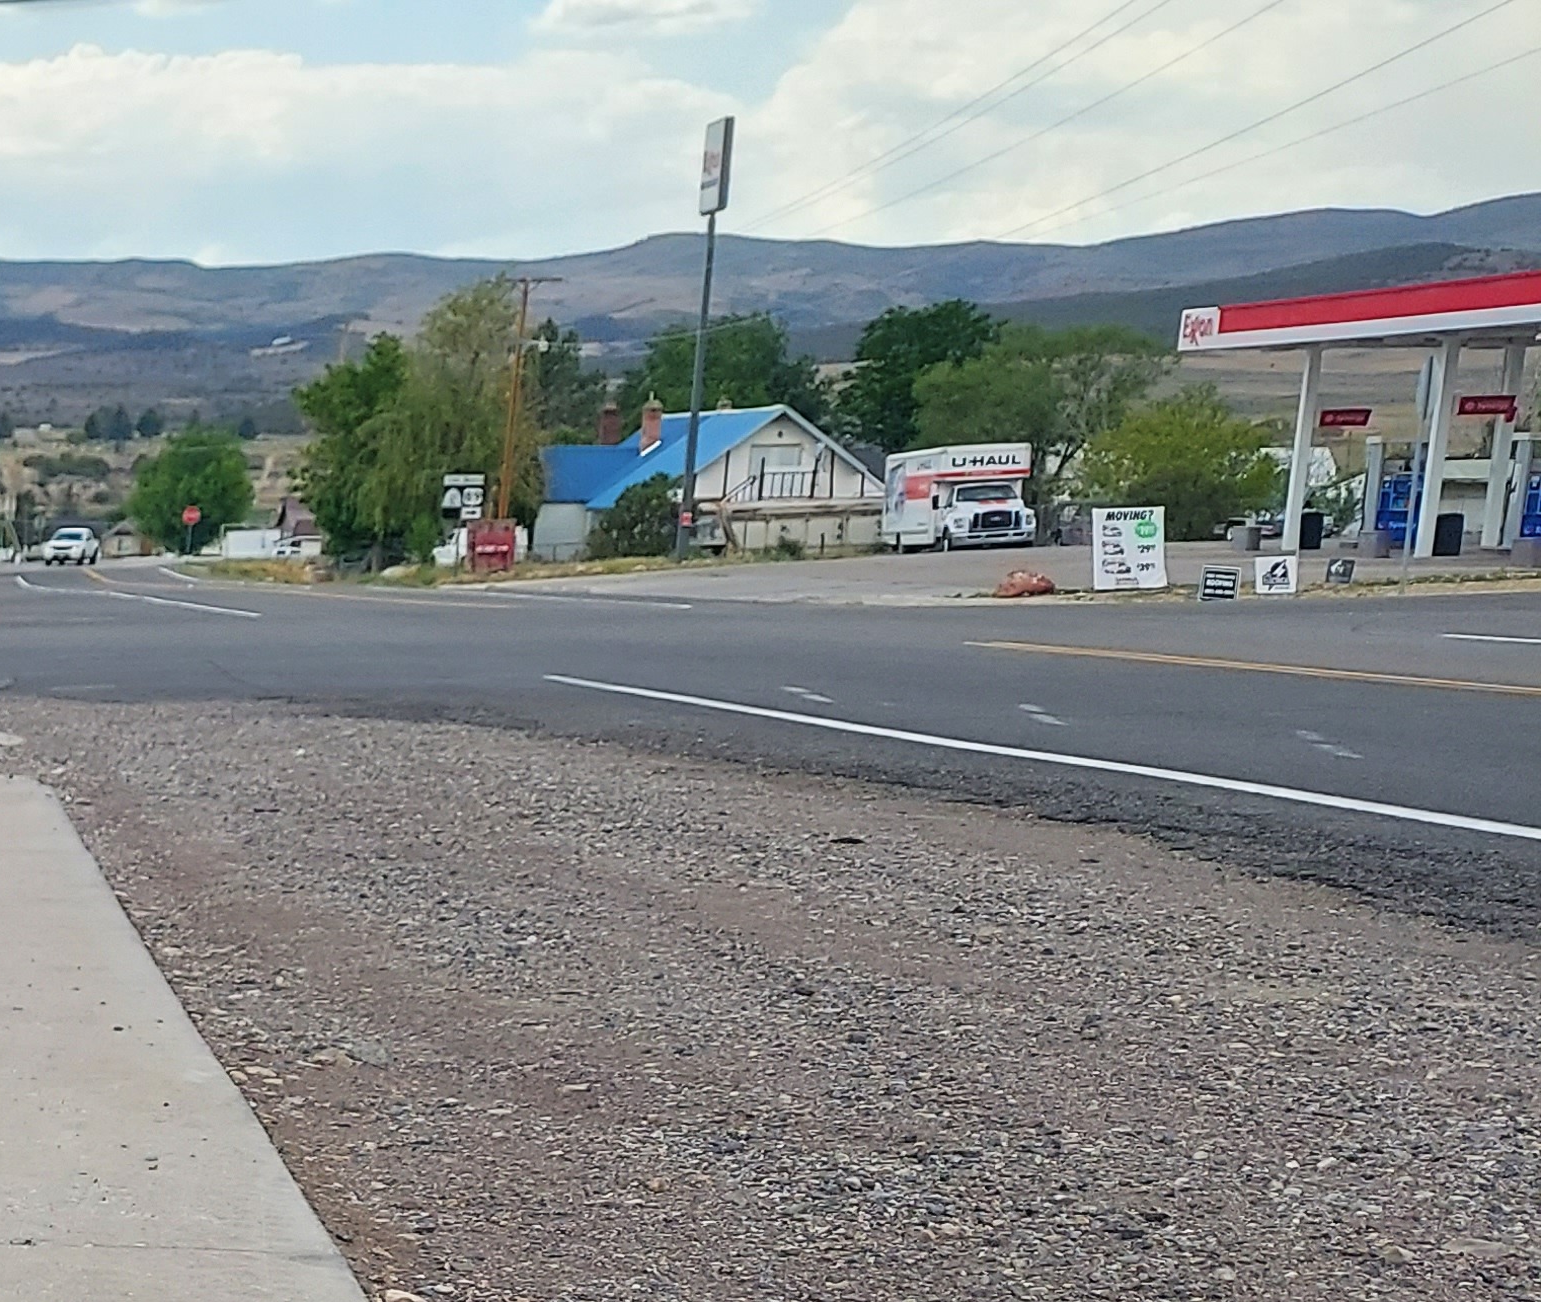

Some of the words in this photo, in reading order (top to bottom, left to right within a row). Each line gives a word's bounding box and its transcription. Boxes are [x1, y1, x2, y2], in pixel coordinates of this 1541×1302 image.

[1183, 313, 1213, 346] Exxon
[952, 454, 1021, 468] U-HAUL
[1105, 510, 1154, 521] MOVING?
